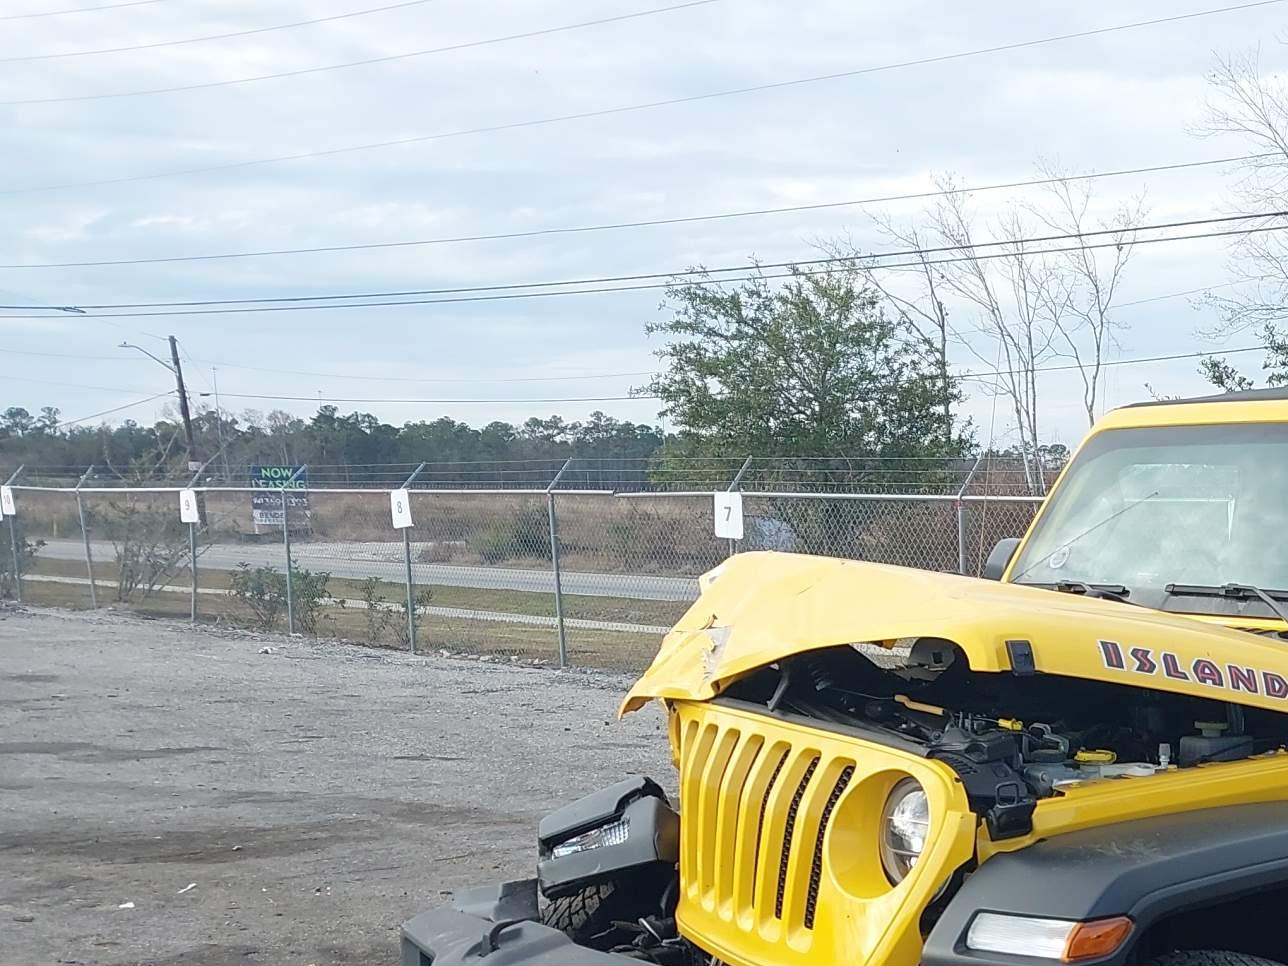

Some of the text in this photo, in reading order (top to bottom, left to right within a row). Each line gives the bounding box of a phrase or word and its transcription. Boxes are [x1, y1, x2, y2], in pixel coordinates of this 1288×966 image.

[261, 467, 293, 478] NOW
[184, 499, 191, 511] 9
[396, 500, 403, 514] 8
[723, 506, 732, 522] 7
